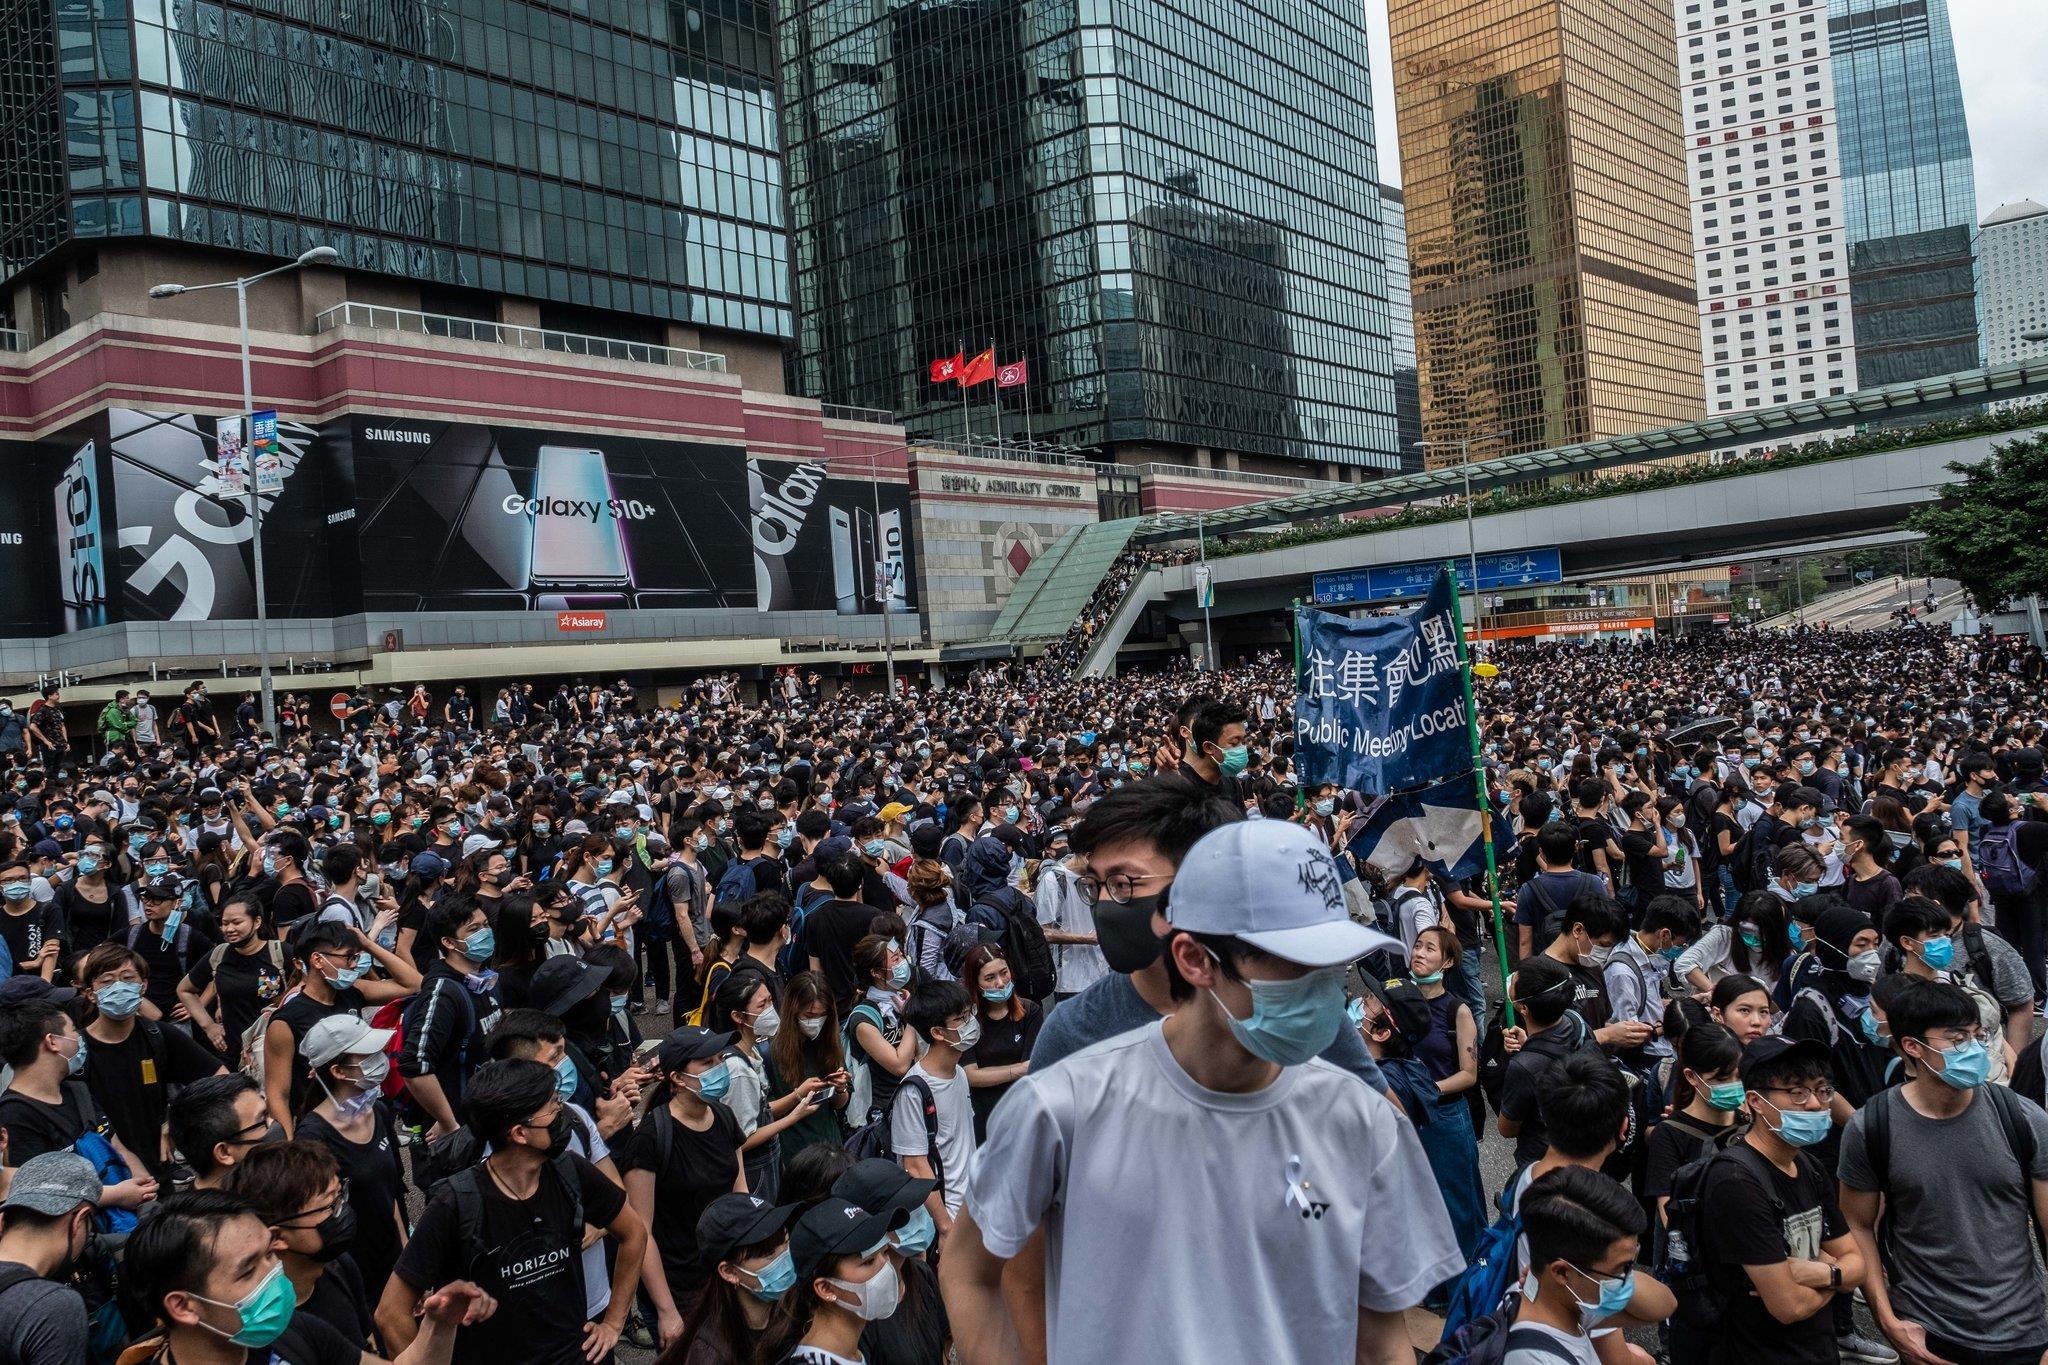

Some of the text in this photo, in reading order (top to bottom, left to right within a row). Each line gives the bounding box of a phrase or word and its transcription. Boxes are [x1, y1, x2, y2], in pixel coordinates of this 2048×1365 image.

[254, 419, 275, 435] 香港
[365, 428, 431, 444] SAMSUNG
[985, 480, 1081, 497] ADMIRALTY CENTRE
[327, 508, 356, 524] SAMSUNG
[502, 494, 656, 523] Galaxy S10+
[0, 533, 22, 545] NG
[885, 526, 905, 582] S10
[1456, 559, 1482, 568] Kowlon
[571, 616, 604, 629] Asiaray
[852, 664, 873, 675] KFC
[1297, 716, 1349, 748] Public
[1353, 724, 1411, 758] Meeing
[501, 1247, 570, 1278] HORIZON
